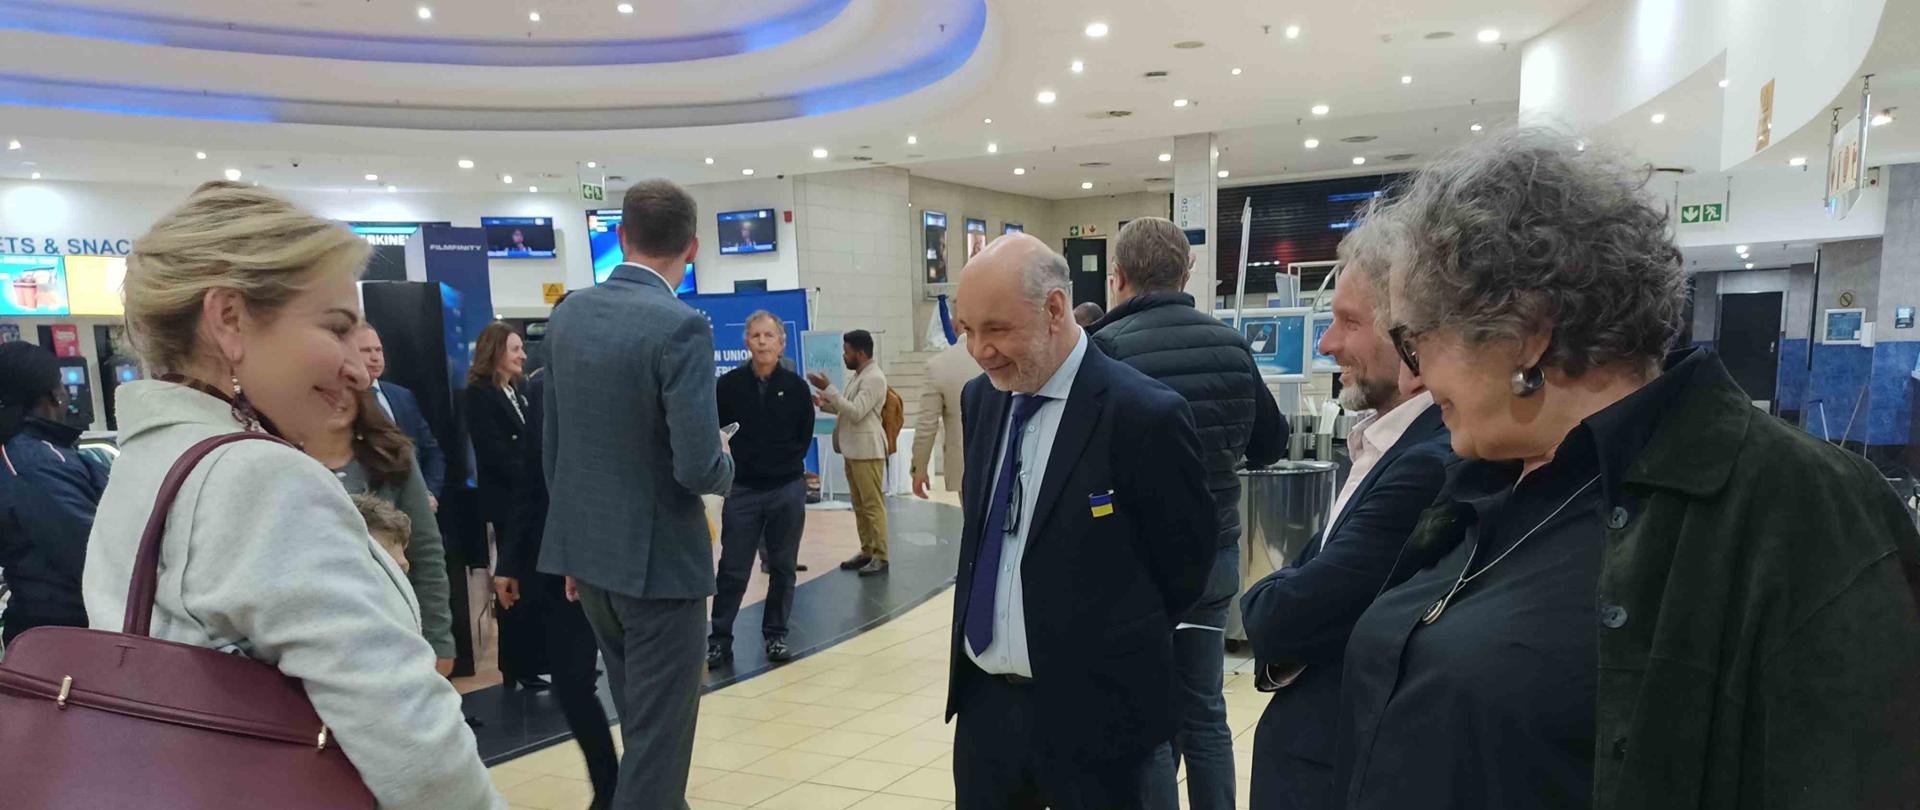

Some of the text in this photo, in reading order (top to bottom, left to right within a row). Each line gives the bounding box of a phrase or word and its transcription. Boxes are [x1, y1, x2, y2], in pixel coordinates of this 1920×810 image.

[44, 239, 60, 255] &
[67, 239, 134, 255] SNAC
[714, 350, 721, 361] N
